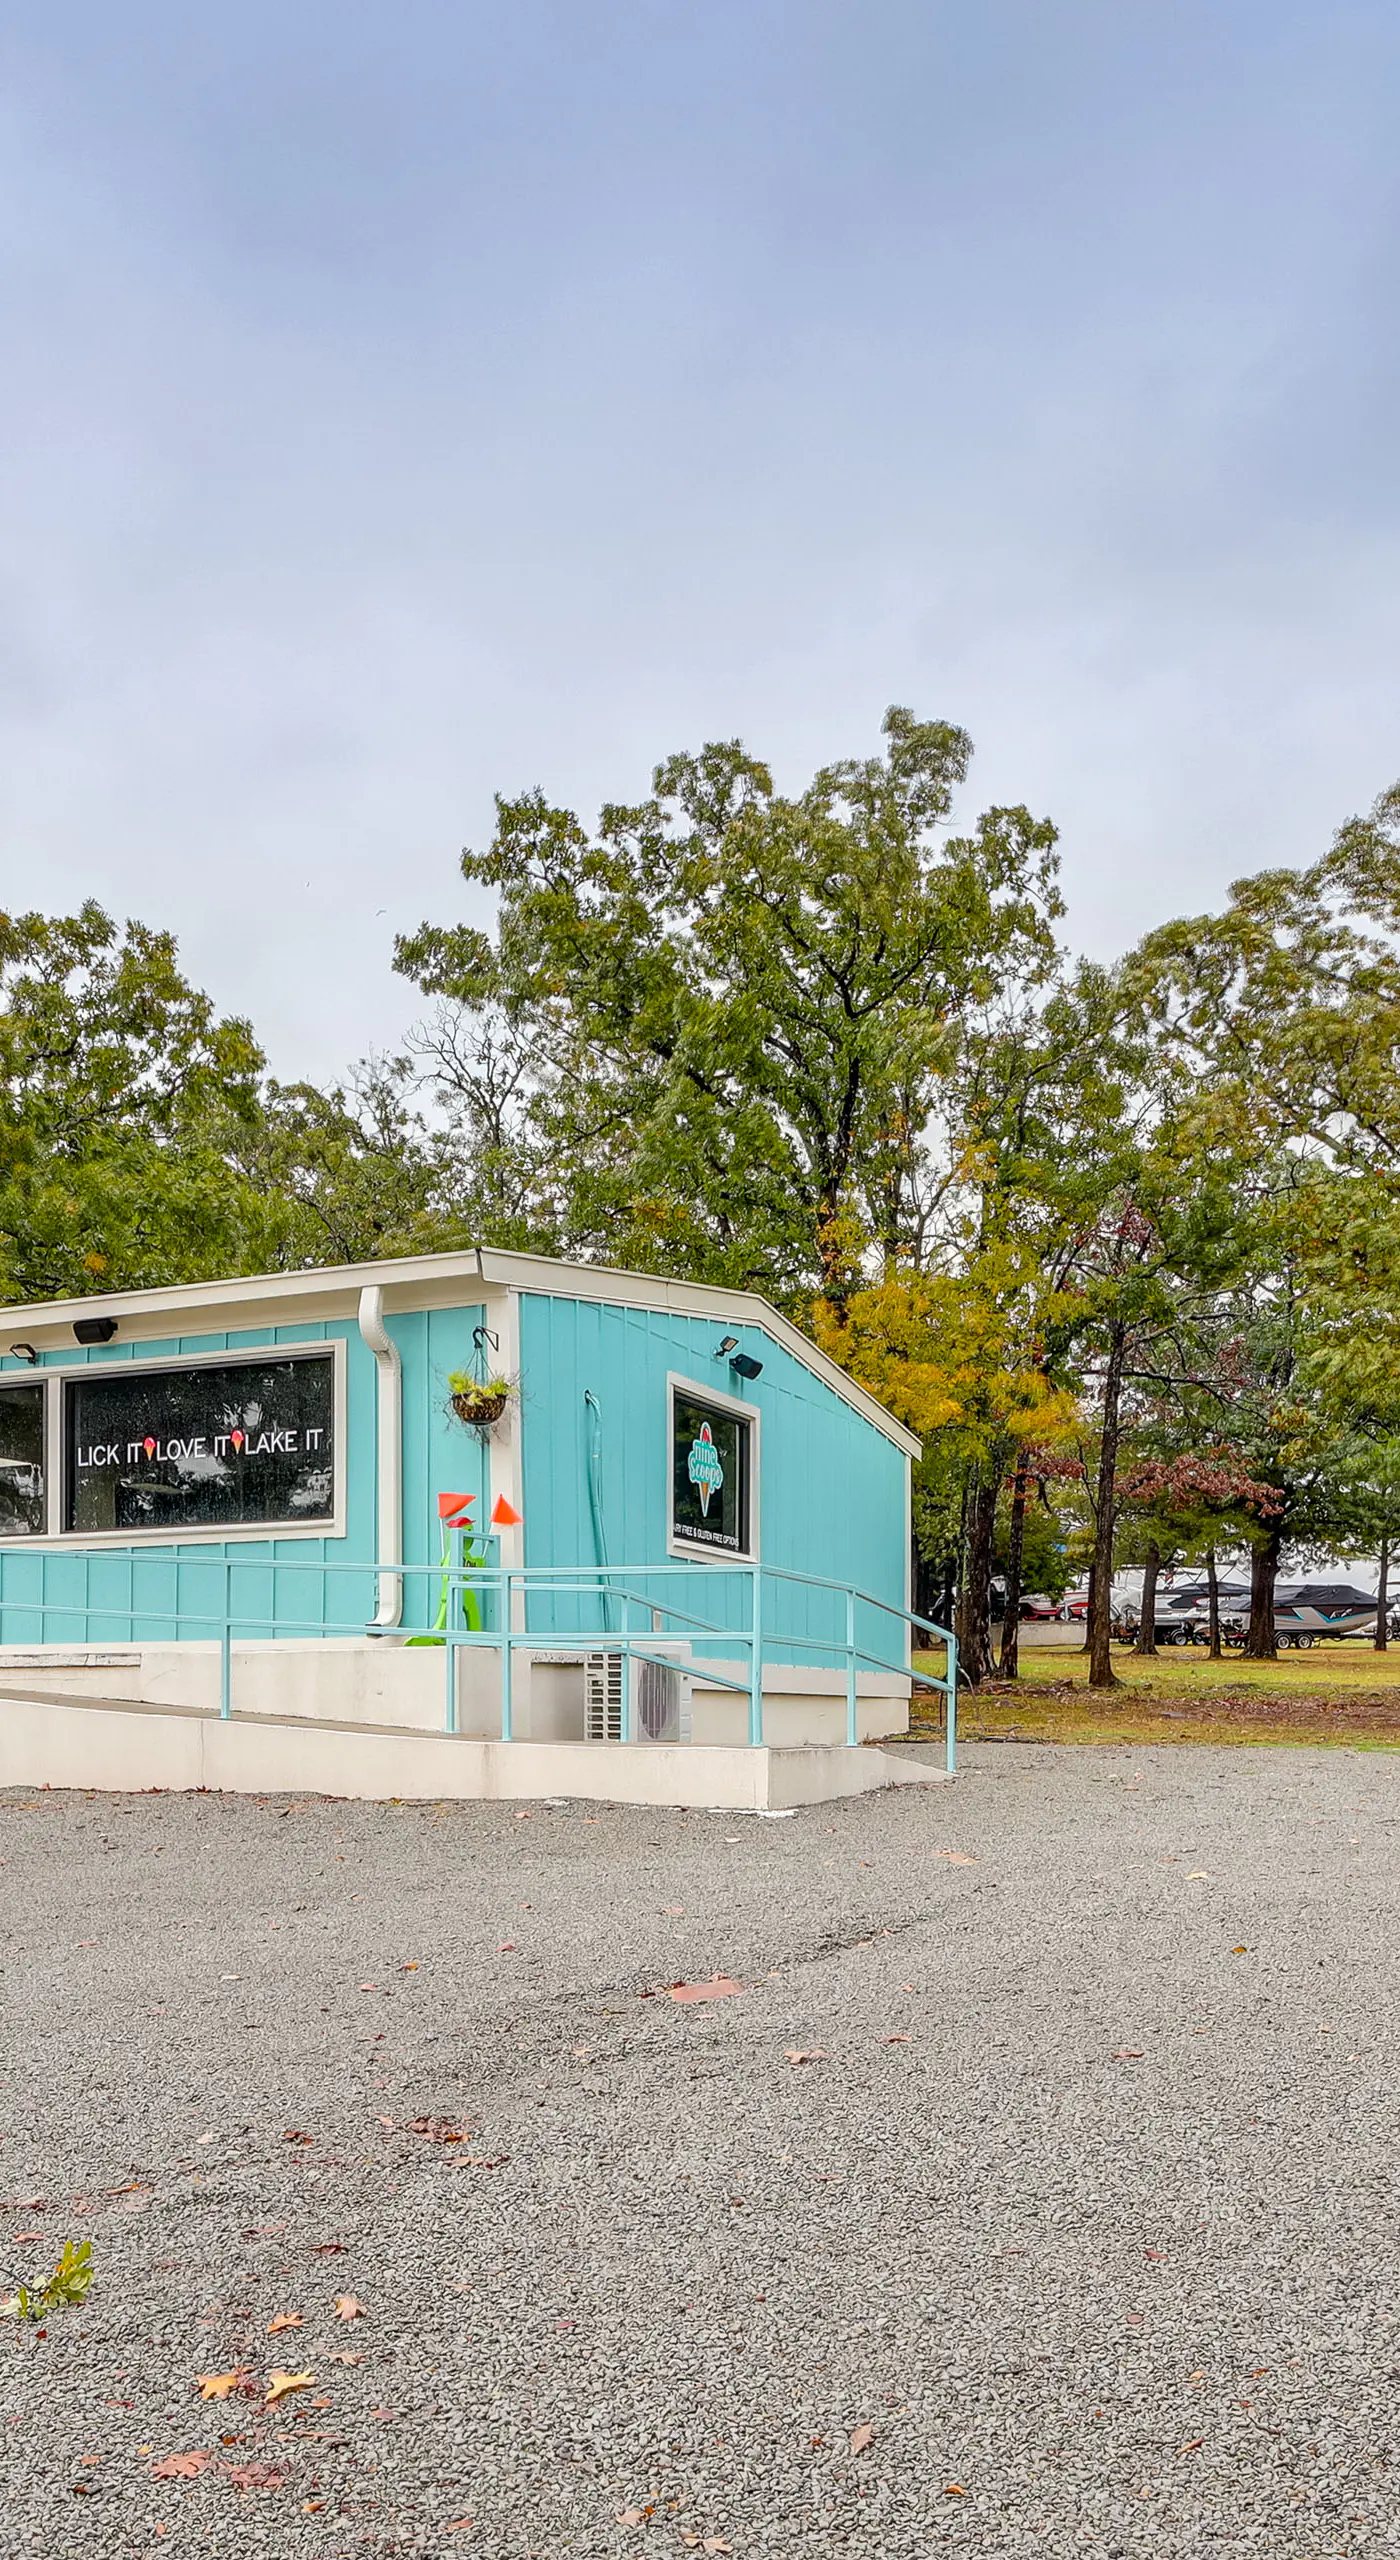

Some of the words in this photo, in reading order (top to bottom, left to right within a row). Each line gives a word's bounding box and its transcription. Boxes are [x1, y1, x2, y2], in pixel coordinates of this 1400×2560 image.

[77, 1443, 120, 1467] LICK
[127, 1441, 143, 1464] IT
[156, 1437, 207, 1461] LOVE
[214, 1434, 231, 1457] IT
[245, 1430, 298, 1455] LAKE
[306, 1428, 324, 1451] IT
[695, 1441, 716, 1466] nine
[690, 1457, 722, 1492] Scoops
[681, 1525, 693, 1537] FREE
[697, 1528, 712, 1541] GLUTEN
[712, 1532, 723, 1544] FREE
